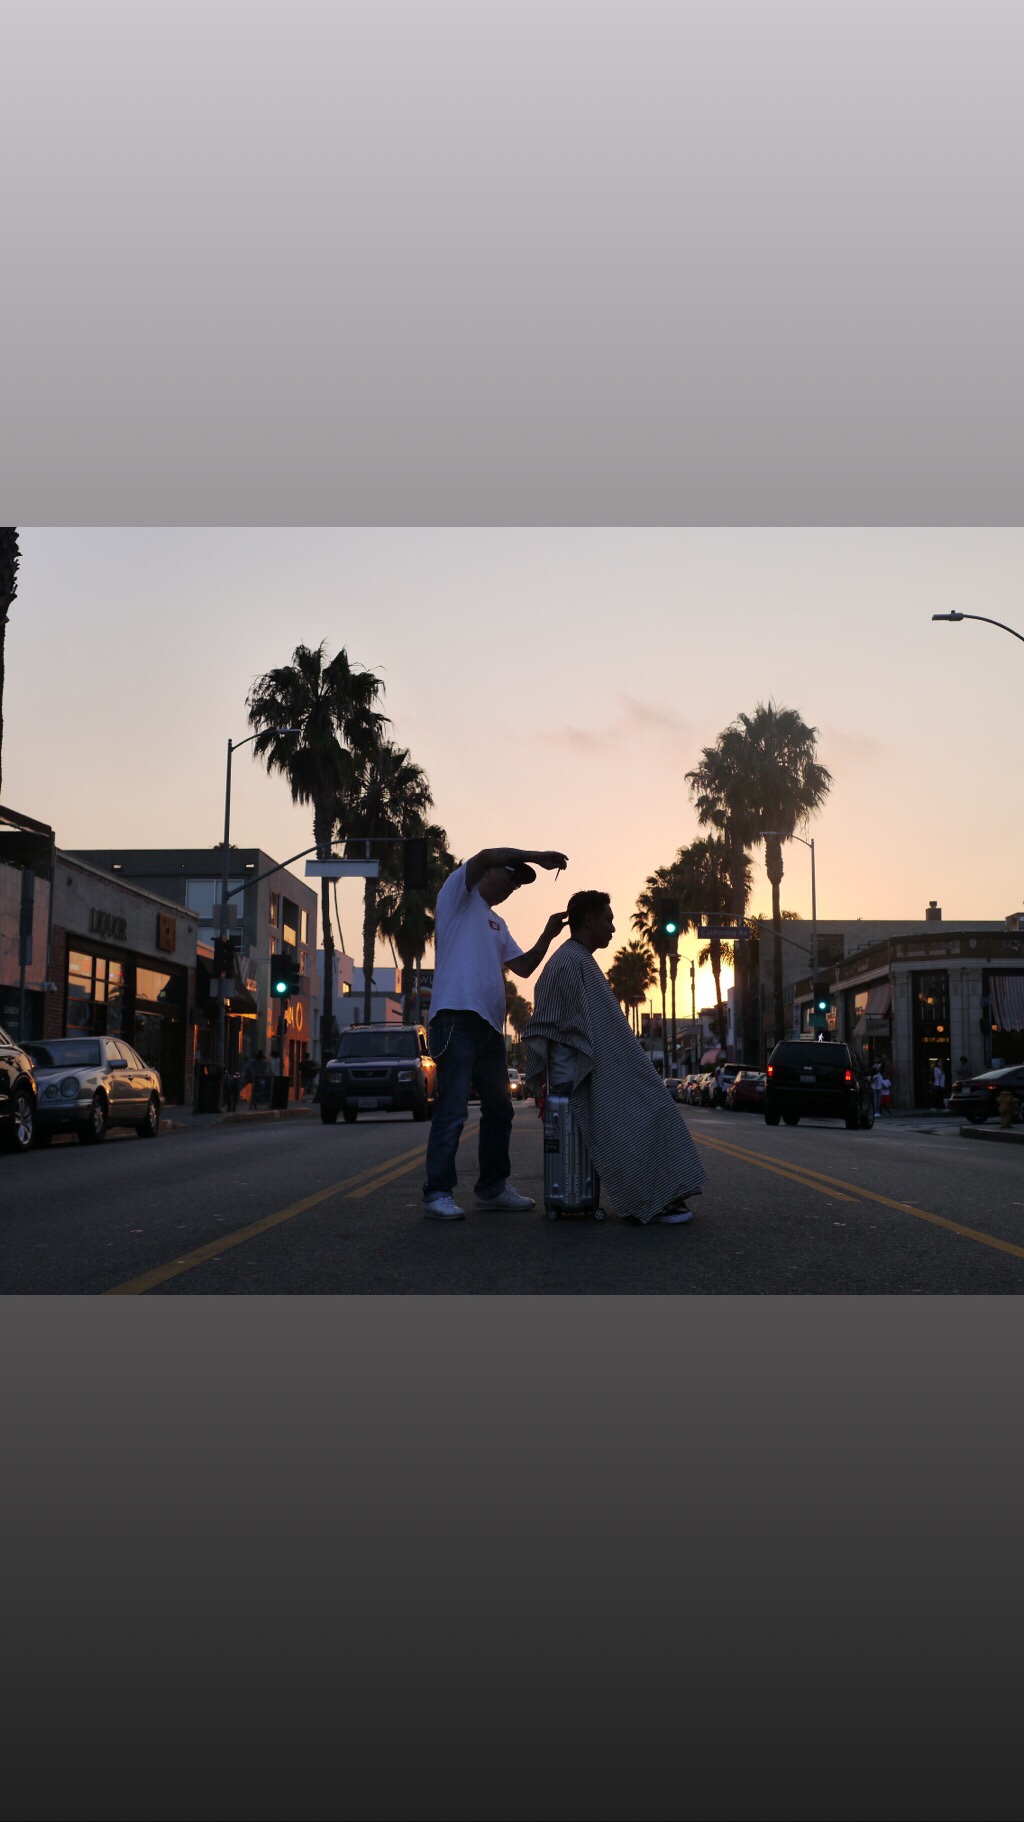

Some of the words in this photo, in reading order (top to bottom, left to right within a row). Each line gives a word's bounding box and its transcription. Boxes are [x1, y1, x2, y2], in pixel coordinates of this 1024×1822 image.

[89, 908, 127, 942] LIQUOR
[701, 928, 736, 937] California
[738, 928, 748, 937] Av
